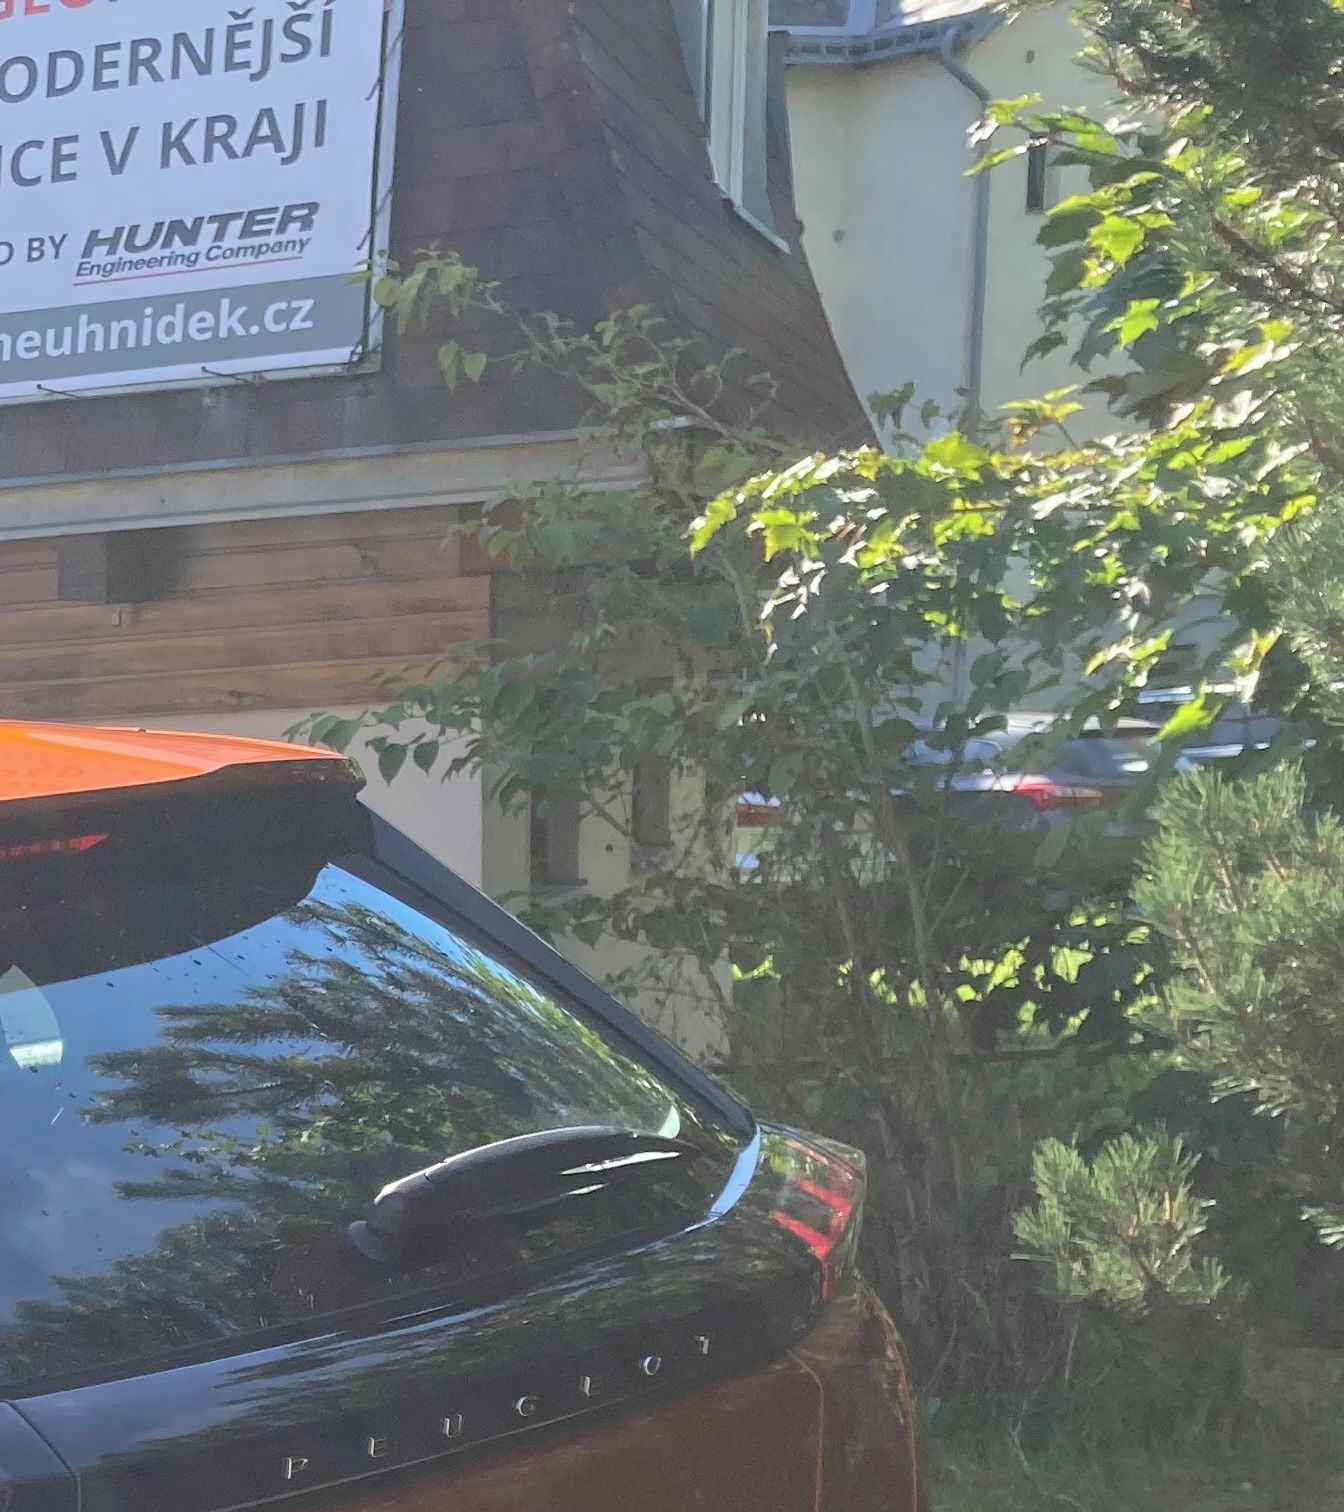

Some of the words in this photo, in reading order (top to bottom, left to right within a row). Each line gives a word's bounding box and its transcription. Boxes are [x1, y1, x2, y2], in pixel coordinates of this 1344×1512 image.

[99, 126, 140, 175] V
[160, 99, 328, 170] KRAJI
[26, 233, 69, 263] BY
[76, 250, 200, 279] Engineering
[205, 237, 310, 266] Company
[81, 201, 321, 260] HUNTER
[282, 1334, 710, 1480] PEUGEOT
